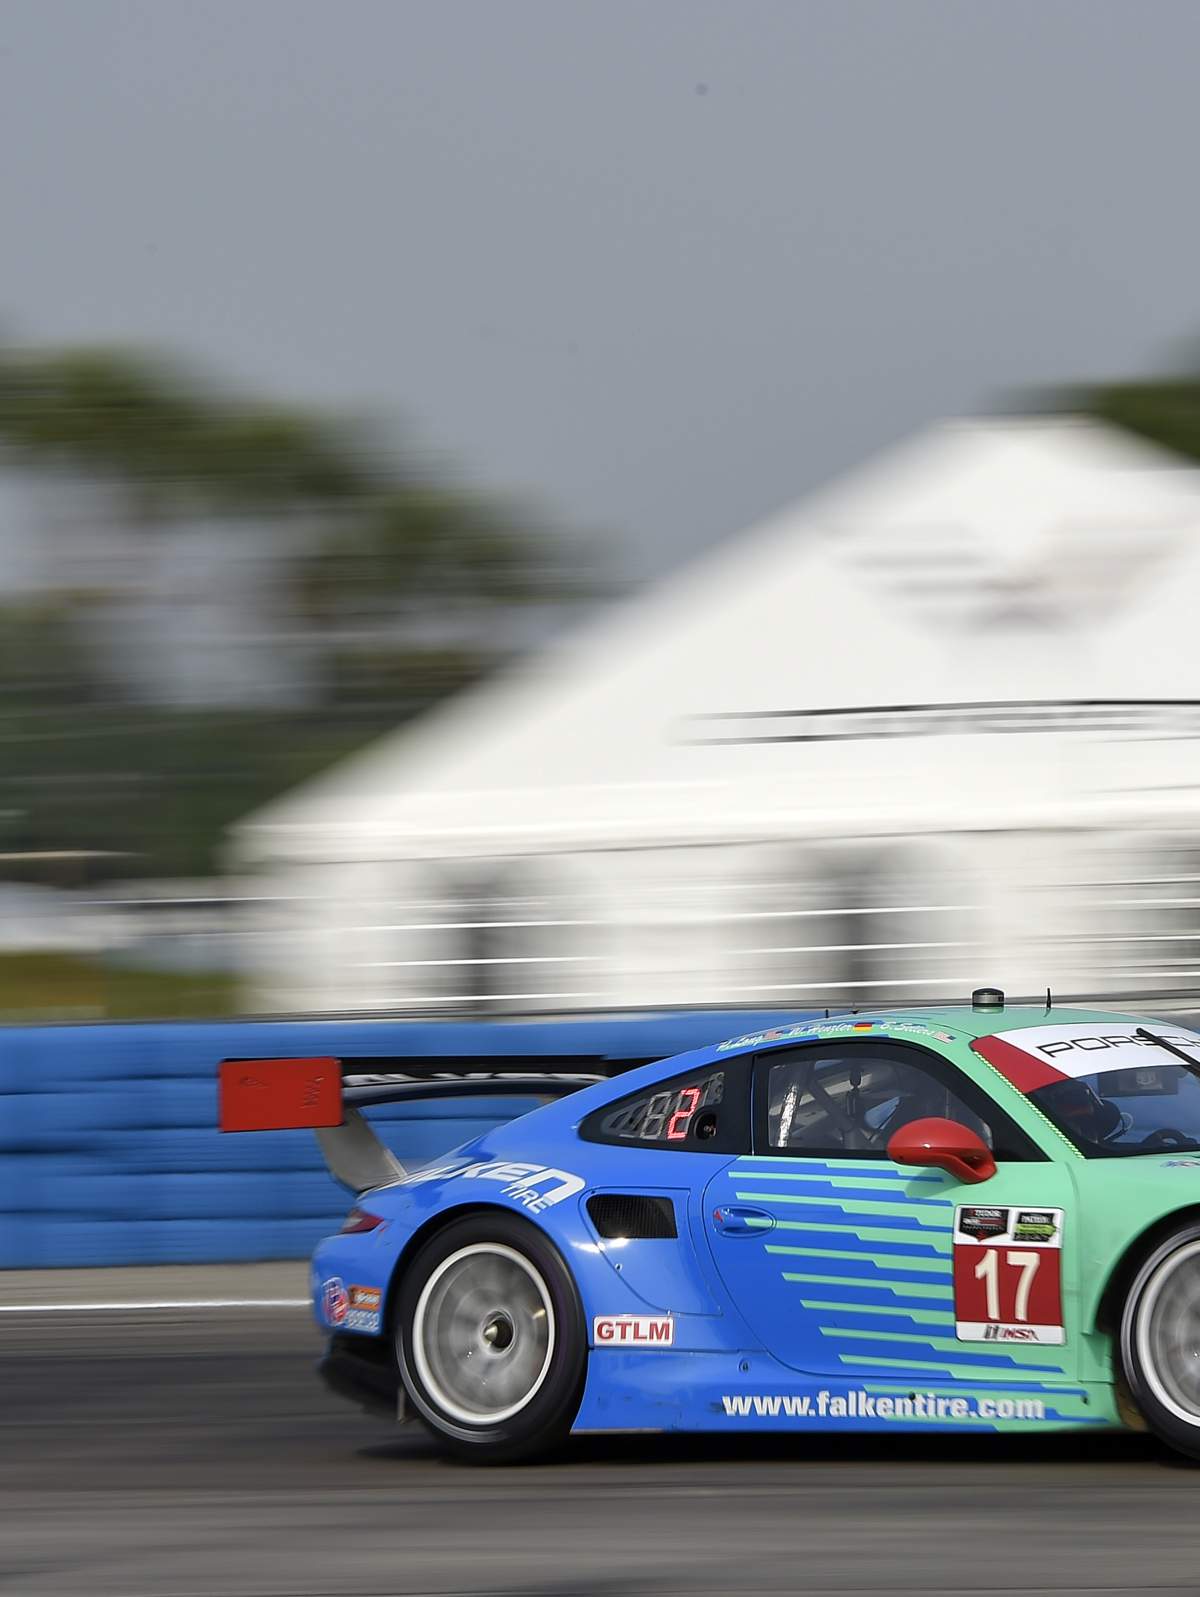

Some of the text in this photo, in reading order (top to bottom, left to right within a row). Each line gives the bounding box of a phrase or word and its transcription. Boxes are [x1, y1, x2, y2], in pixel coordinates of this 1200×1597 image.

[666, 1087, 702, 1140] 2
[374, 1161, 586, 1206] LKEN
[499, 1182, 554, 1215] TIRE
[974, 1248, 1041, 1322] 17
[596, 1319, 671, 1342] GTLM
[721, 1389, 1046, 1421] www.falkentire.com
